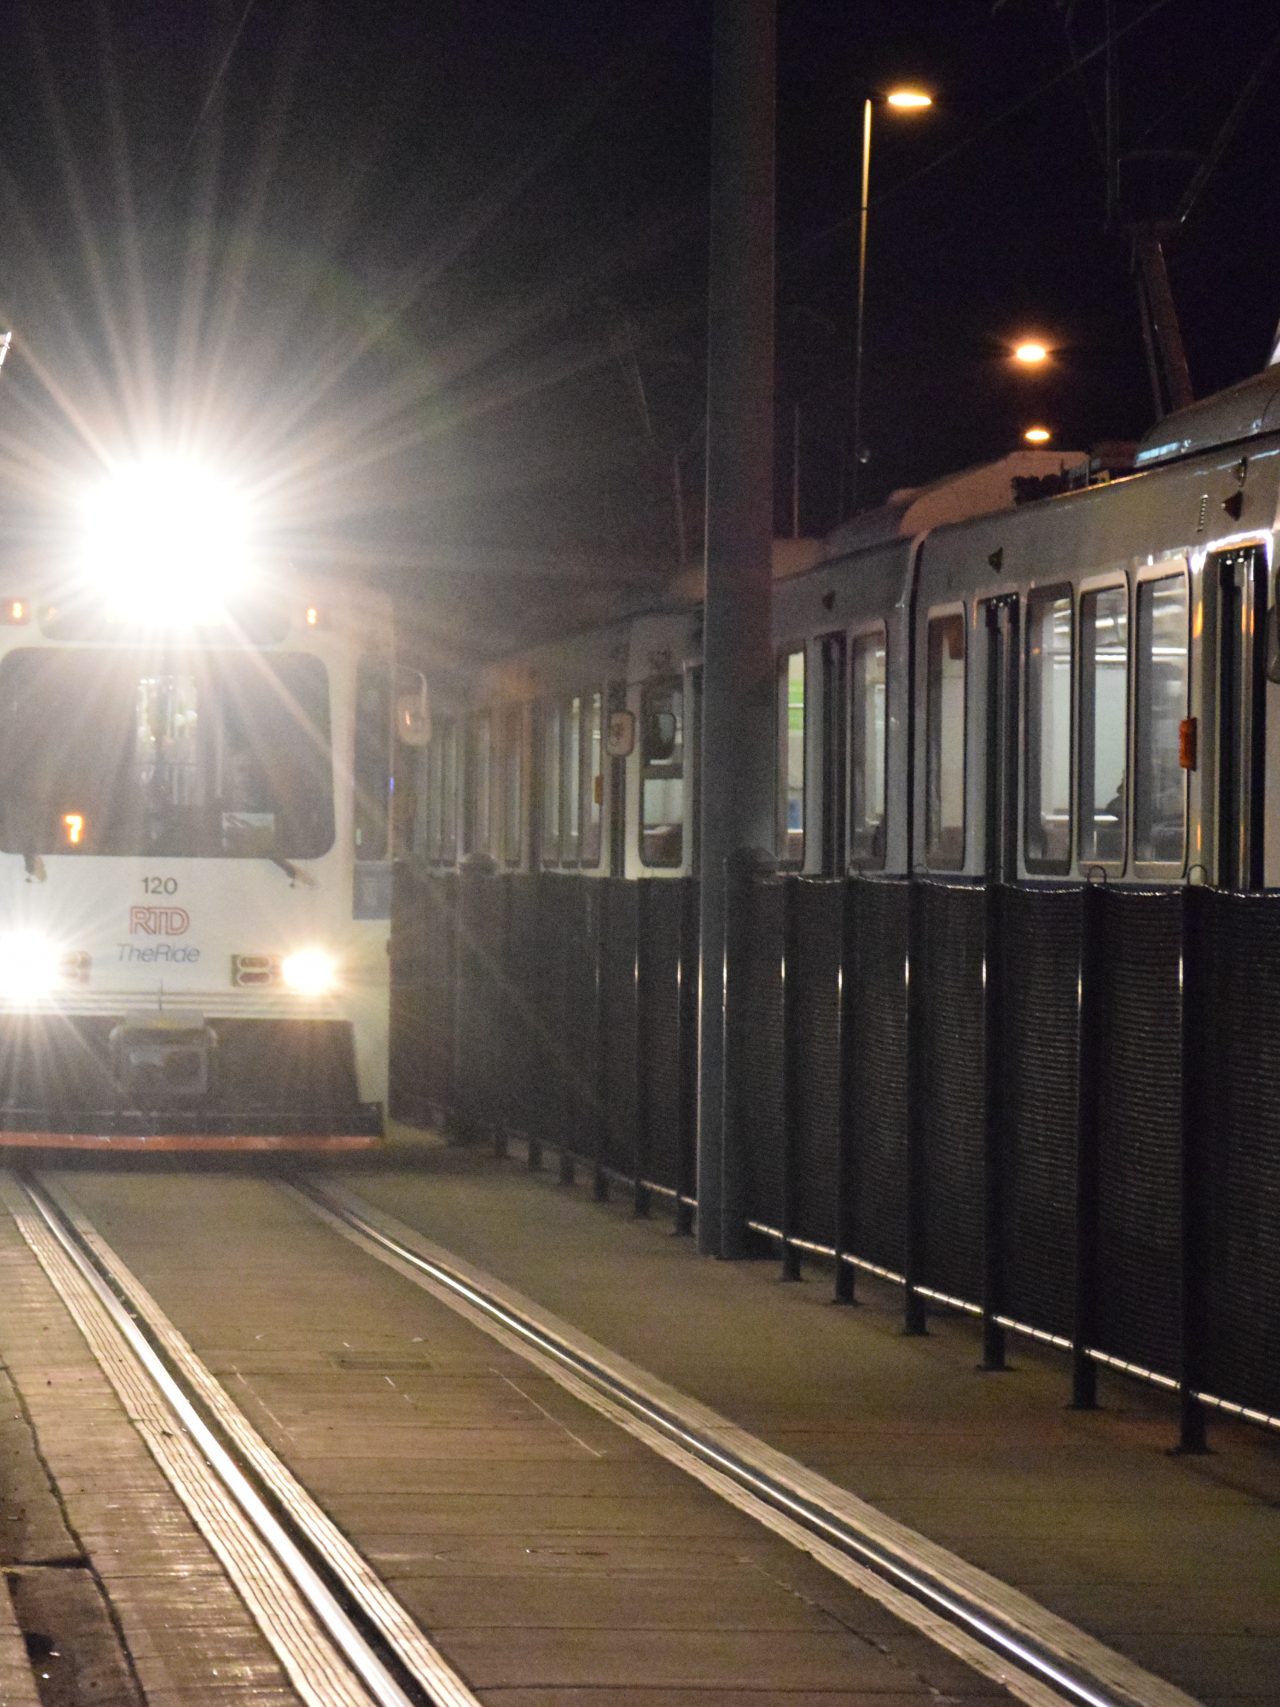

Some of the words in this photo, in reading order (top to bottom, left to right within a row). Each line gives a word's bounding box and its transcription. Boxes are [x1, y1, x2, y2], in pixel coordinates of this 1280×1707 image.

[65, 815, 83, 843] 7
[141, 876, 179, 895] 120
[129, 905, 190, 936] RTD
[117, 943, 201, 963] TheRide
